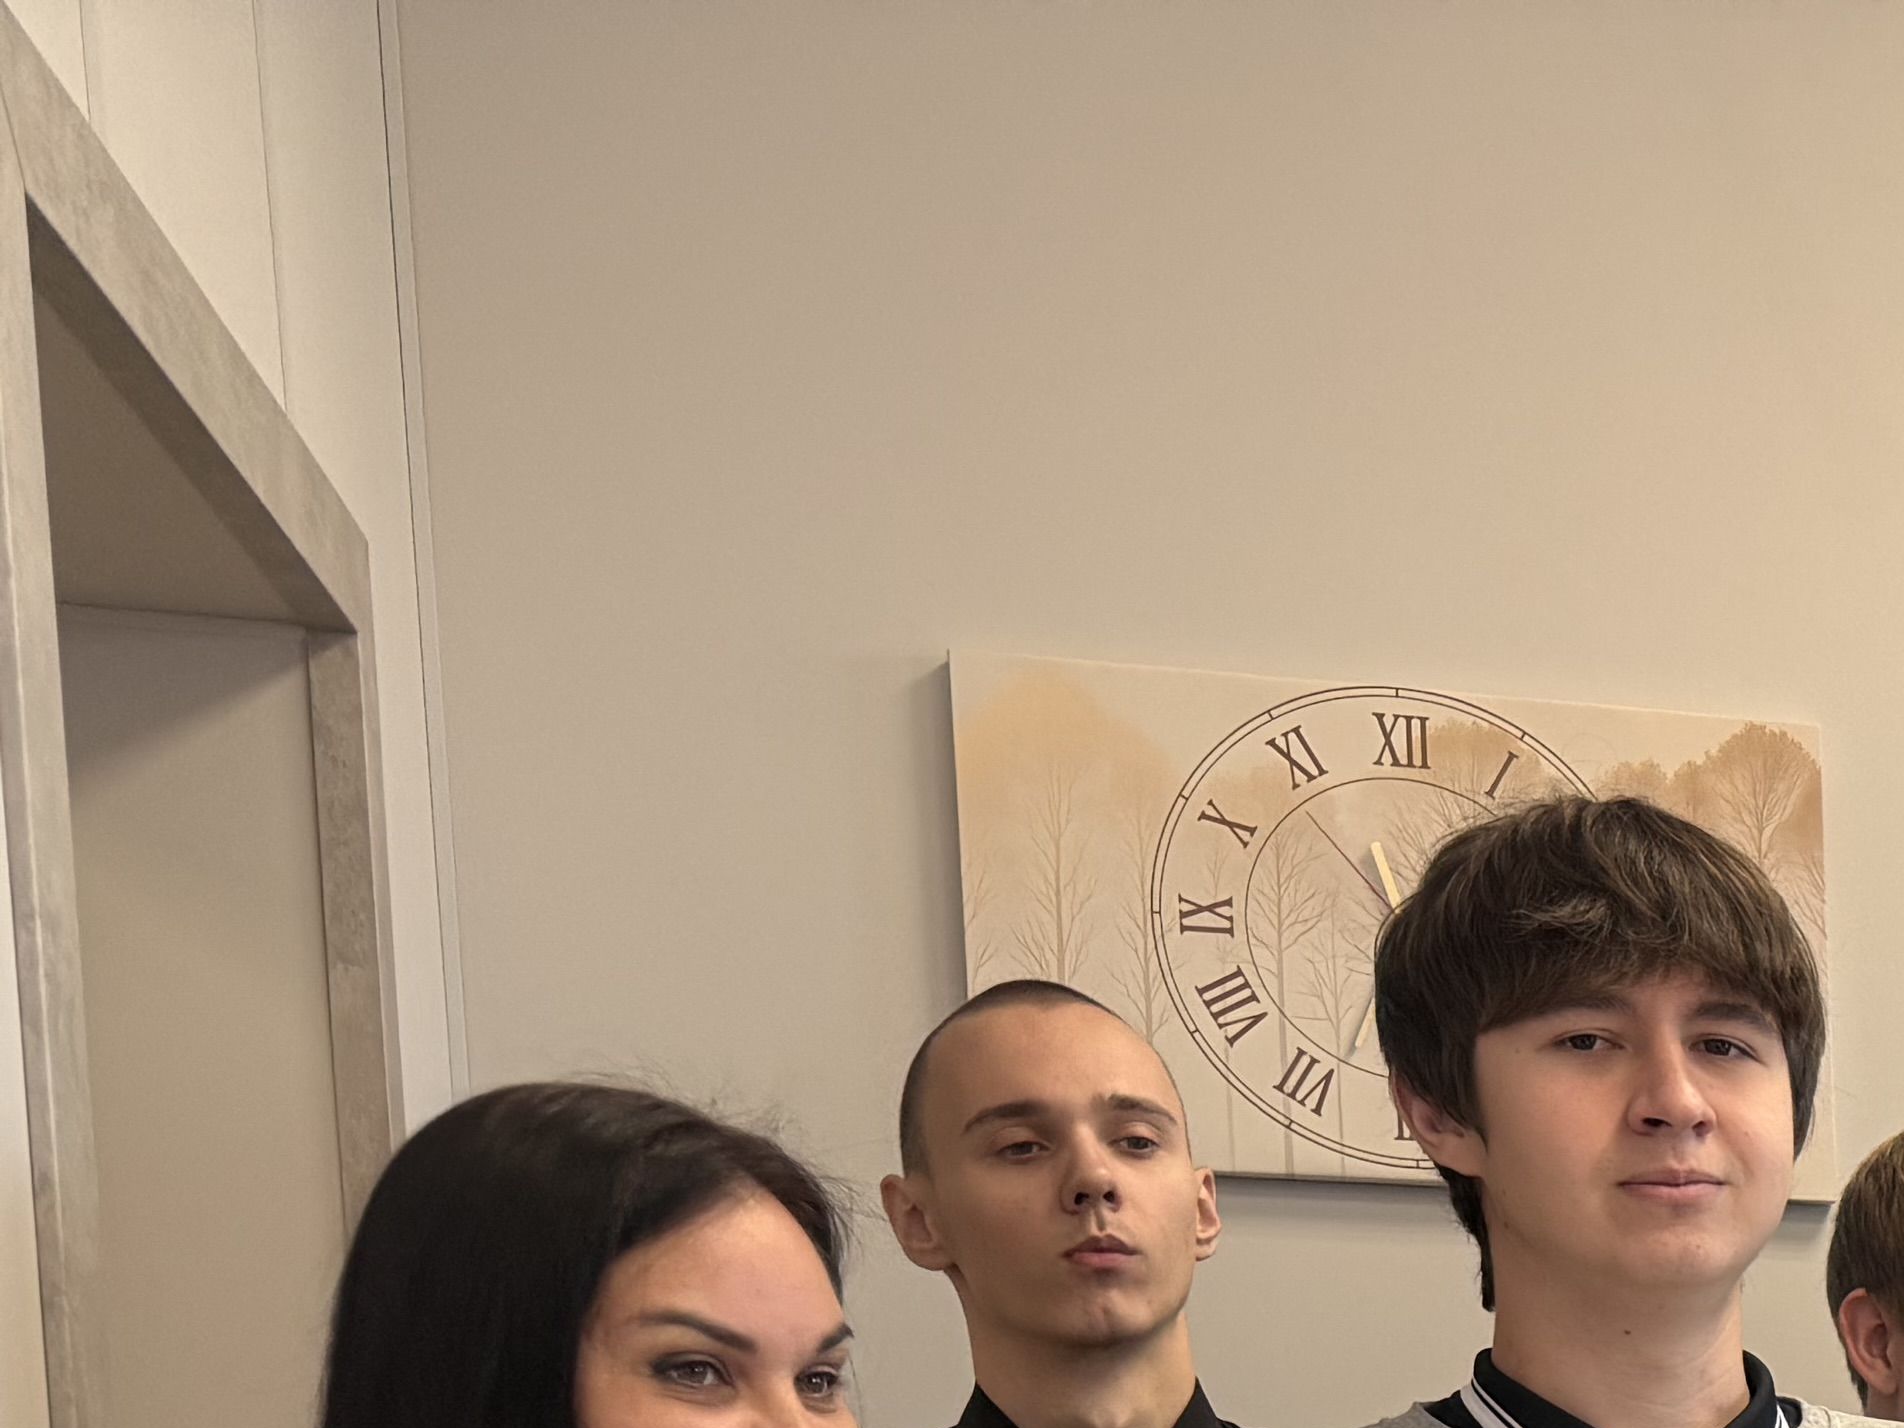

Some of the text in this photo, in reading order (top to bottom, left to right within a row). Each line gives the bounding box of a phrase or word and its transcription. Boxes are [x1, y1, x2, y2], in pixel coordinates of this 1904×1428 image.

[1266, 725, 1328, 790] XI
[1373, 712, 1431, 770] XII
[1484, 750, 1519, 800] I
[1198, 799, 1258, 848] X
[1179, 893, 1234, 936] IX
[1197, 965, 1267, 1048] VIII
[1273, 1047, 1336, 1118] VII
